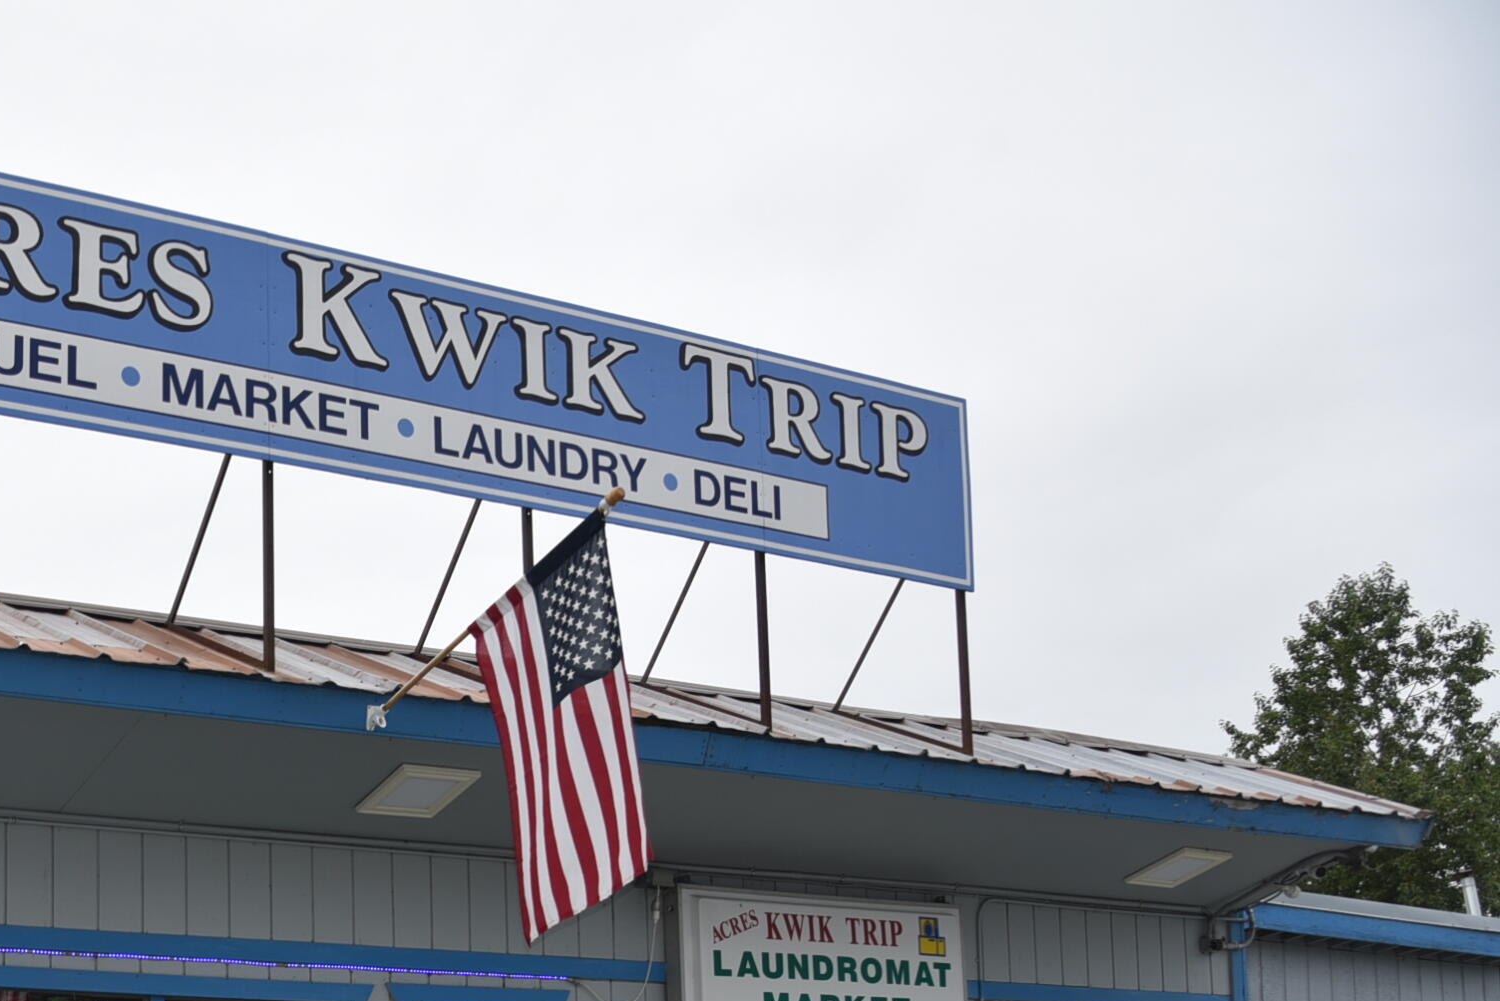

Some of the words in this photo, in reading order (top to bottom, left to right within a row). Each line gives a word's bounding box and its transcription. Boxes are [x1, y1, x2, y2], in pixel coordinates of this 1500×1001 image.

[281, 250, 646, 424] KWIK
[680, 342, 929, 482] TRIP
[162, 361, 379, 440] MARKET
[434, 415, 647, 493] LAUNDRY
[694, 469, 782, 520] DELI
[712, 909, 759, 944] ACRES
[765, 911, 834, 943] KWIK
[845, 917, 903, 947] TRIP
[713, 949, 952, 988] LAUNDROMAT
